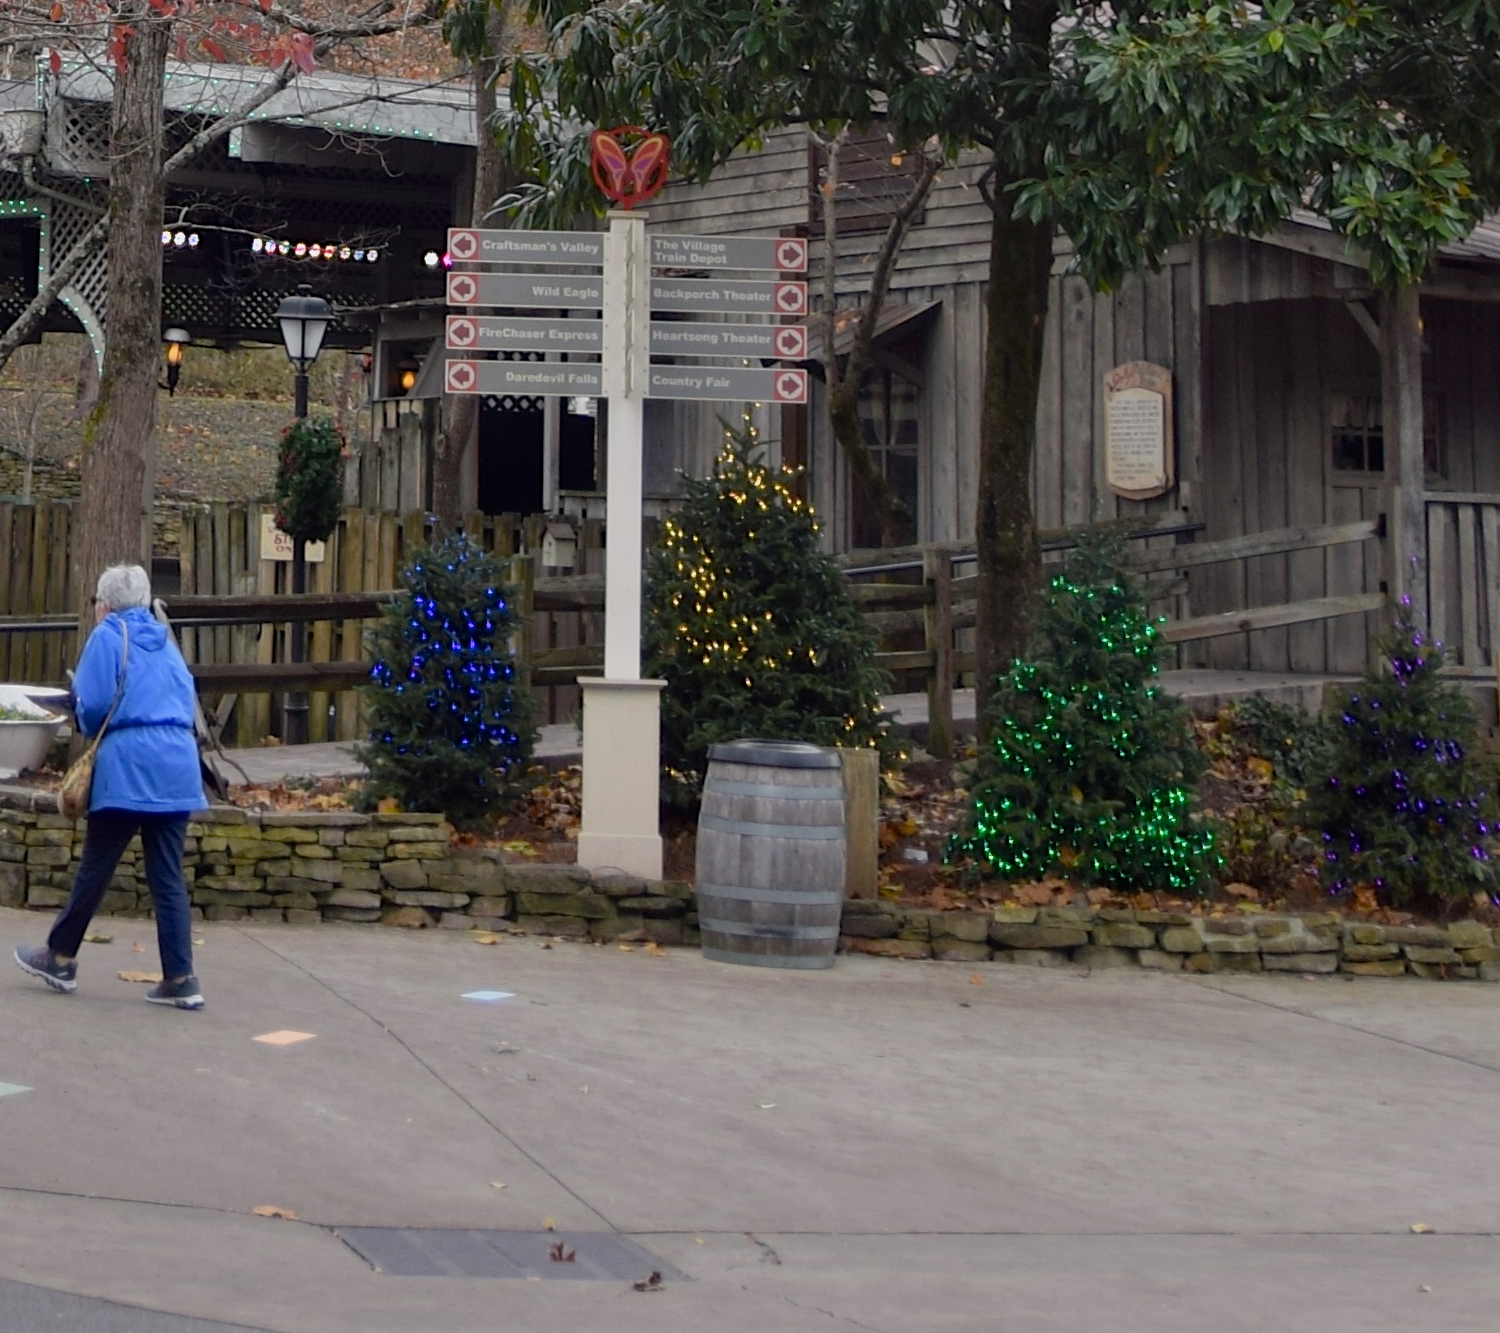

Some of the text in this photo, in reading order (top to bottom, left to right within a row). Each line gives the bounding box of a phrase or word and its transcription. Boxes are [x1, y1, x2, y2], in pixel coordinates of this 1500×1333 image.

[482, 239, 599, 255] Craftsman's Valley
[654, 239, 726, 253] The Village
[654, 251, 727, 265] Train Depot
[531, 285, 599, 300] Wild Eagle
[653, 288, 771, 301] Backporch Theater
[478, 327, 598, 341] FireChaser Express
[652, 330, 771, 344] Heartsong Theater
[505, 372, 598, 384] Daredevil Falls
[652, 375, 731, 389] Country Fair
